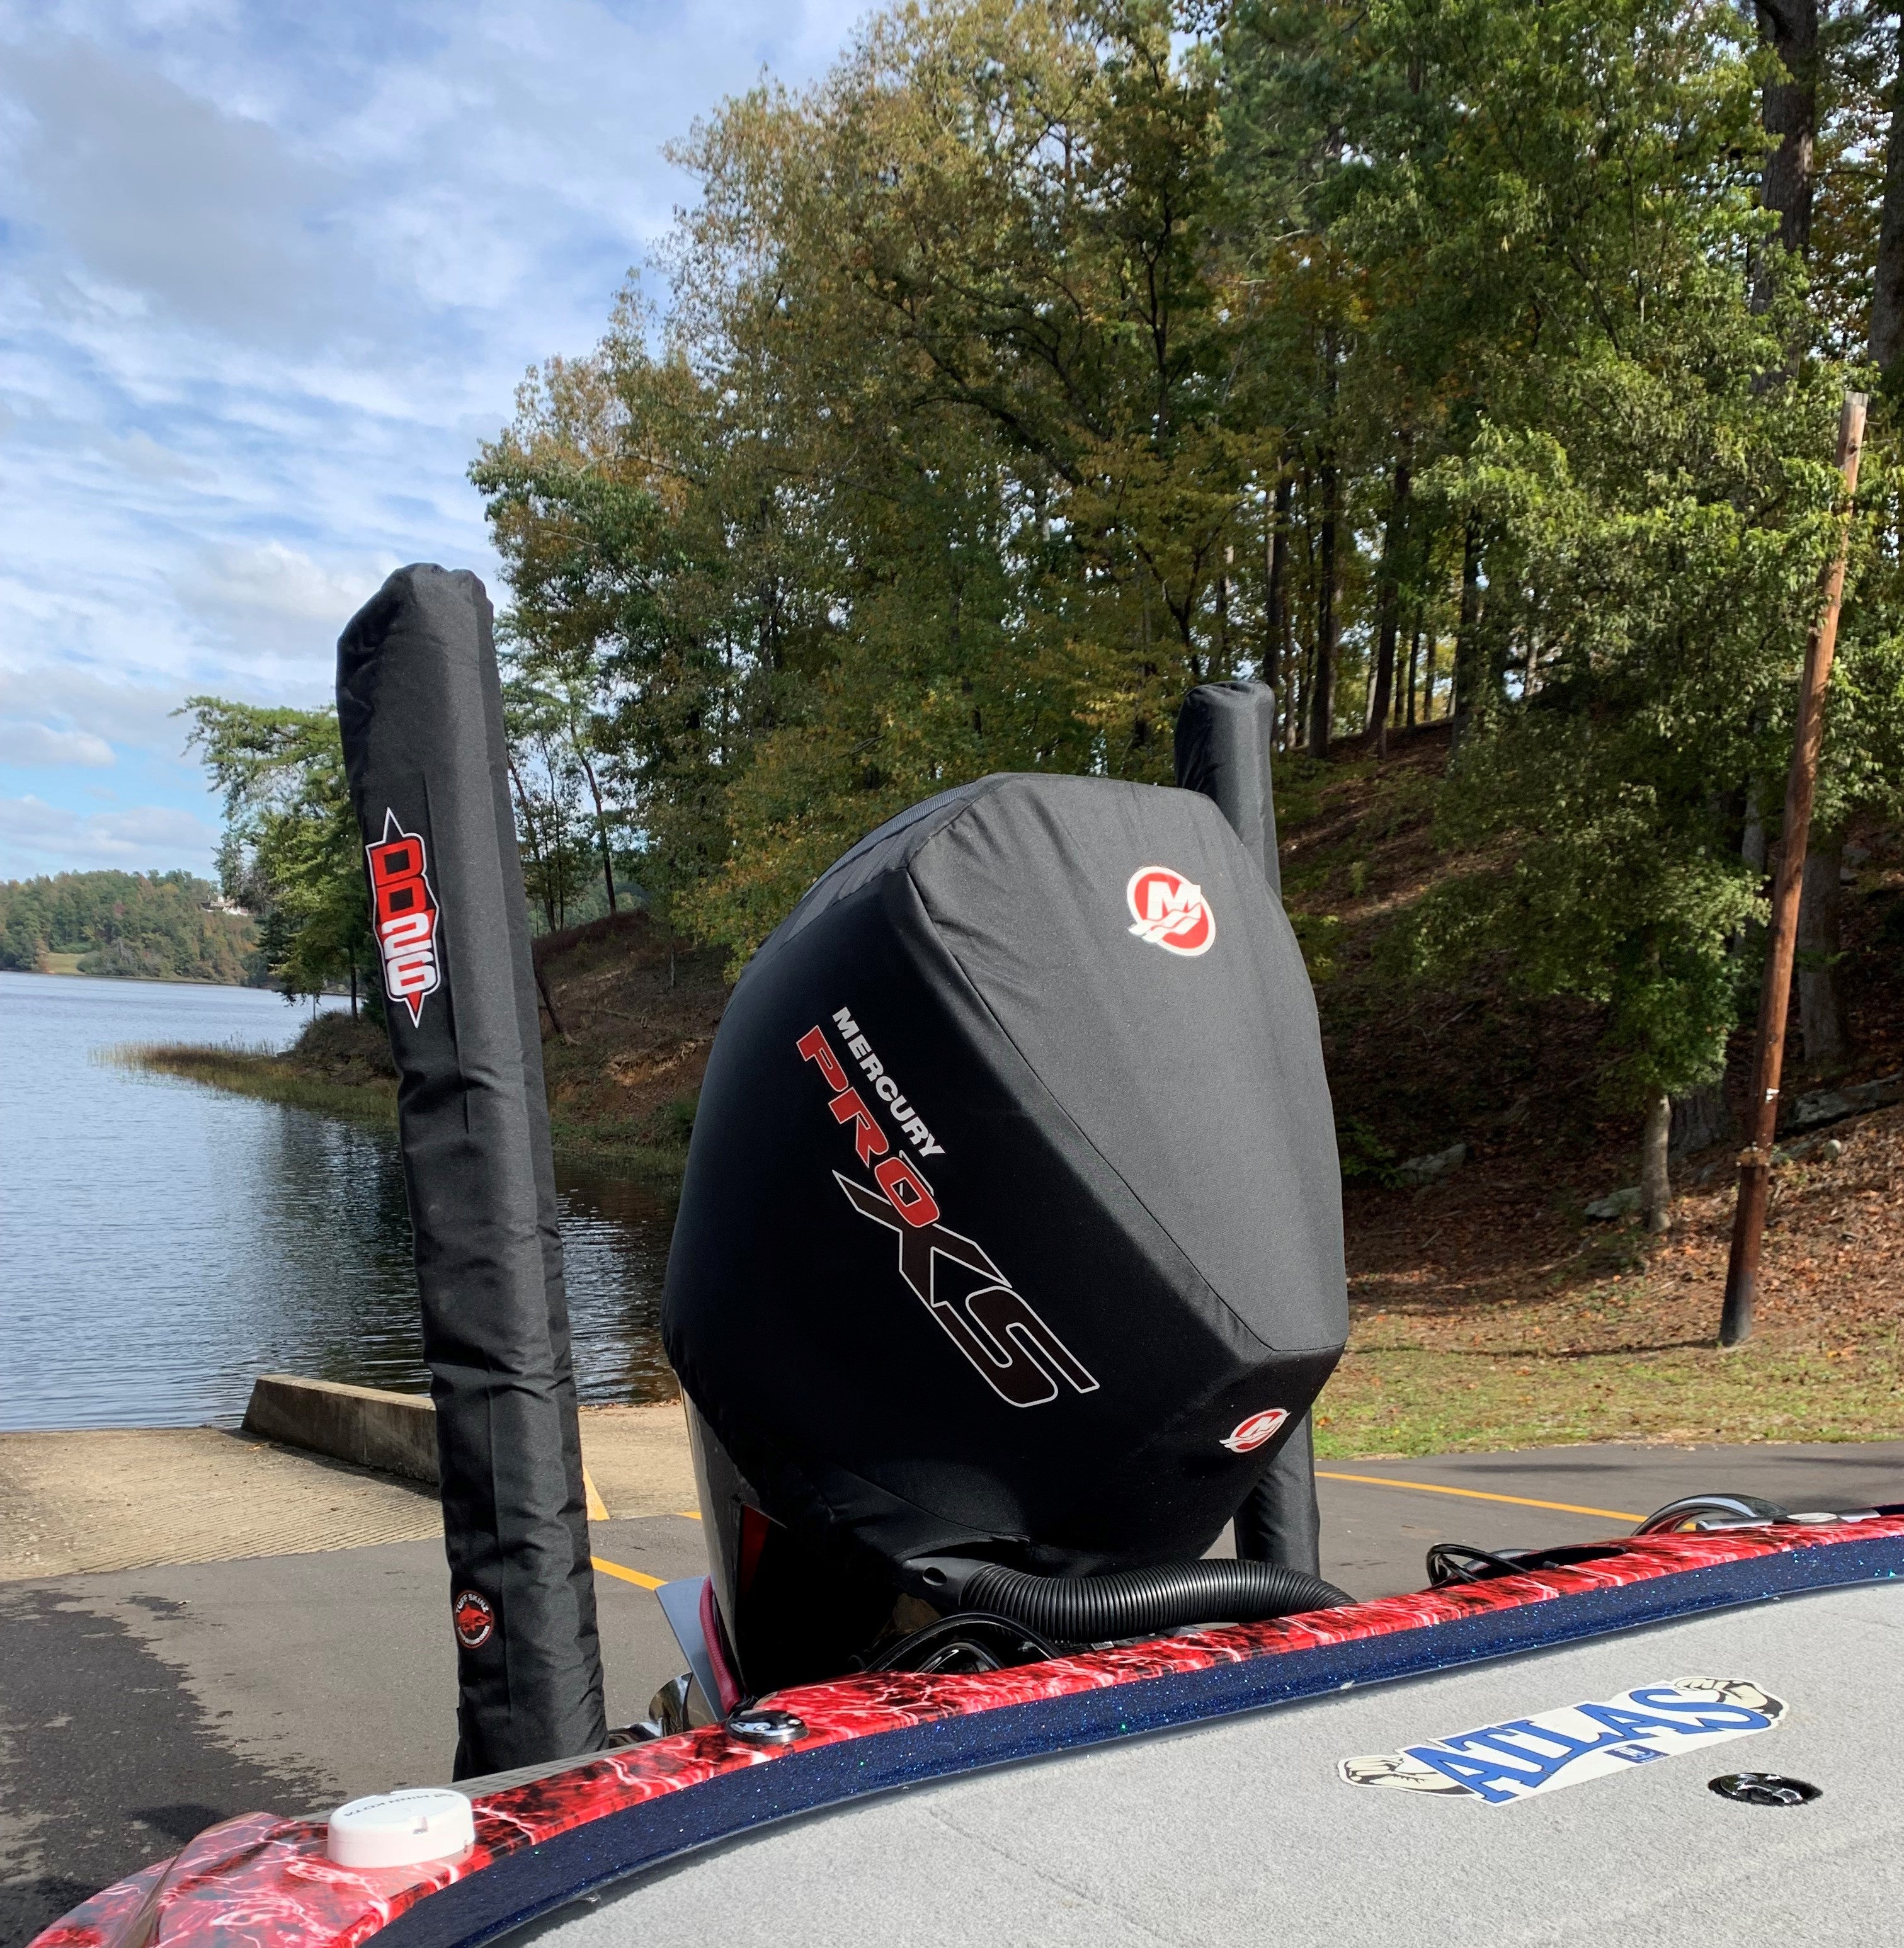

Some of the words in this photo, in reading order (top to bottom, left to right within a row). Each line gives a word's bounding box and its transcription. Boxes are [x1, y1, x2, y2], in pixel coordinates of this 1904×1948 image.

[371, 838, 438, 996] DD26
[795, 1024, 940, 1228] PRO
[832, 1006, 945, 1158] MERCURY
[832, 1149, 1100, 1408] XS
[1403, 1688, 1772, 1804] ATLAS
